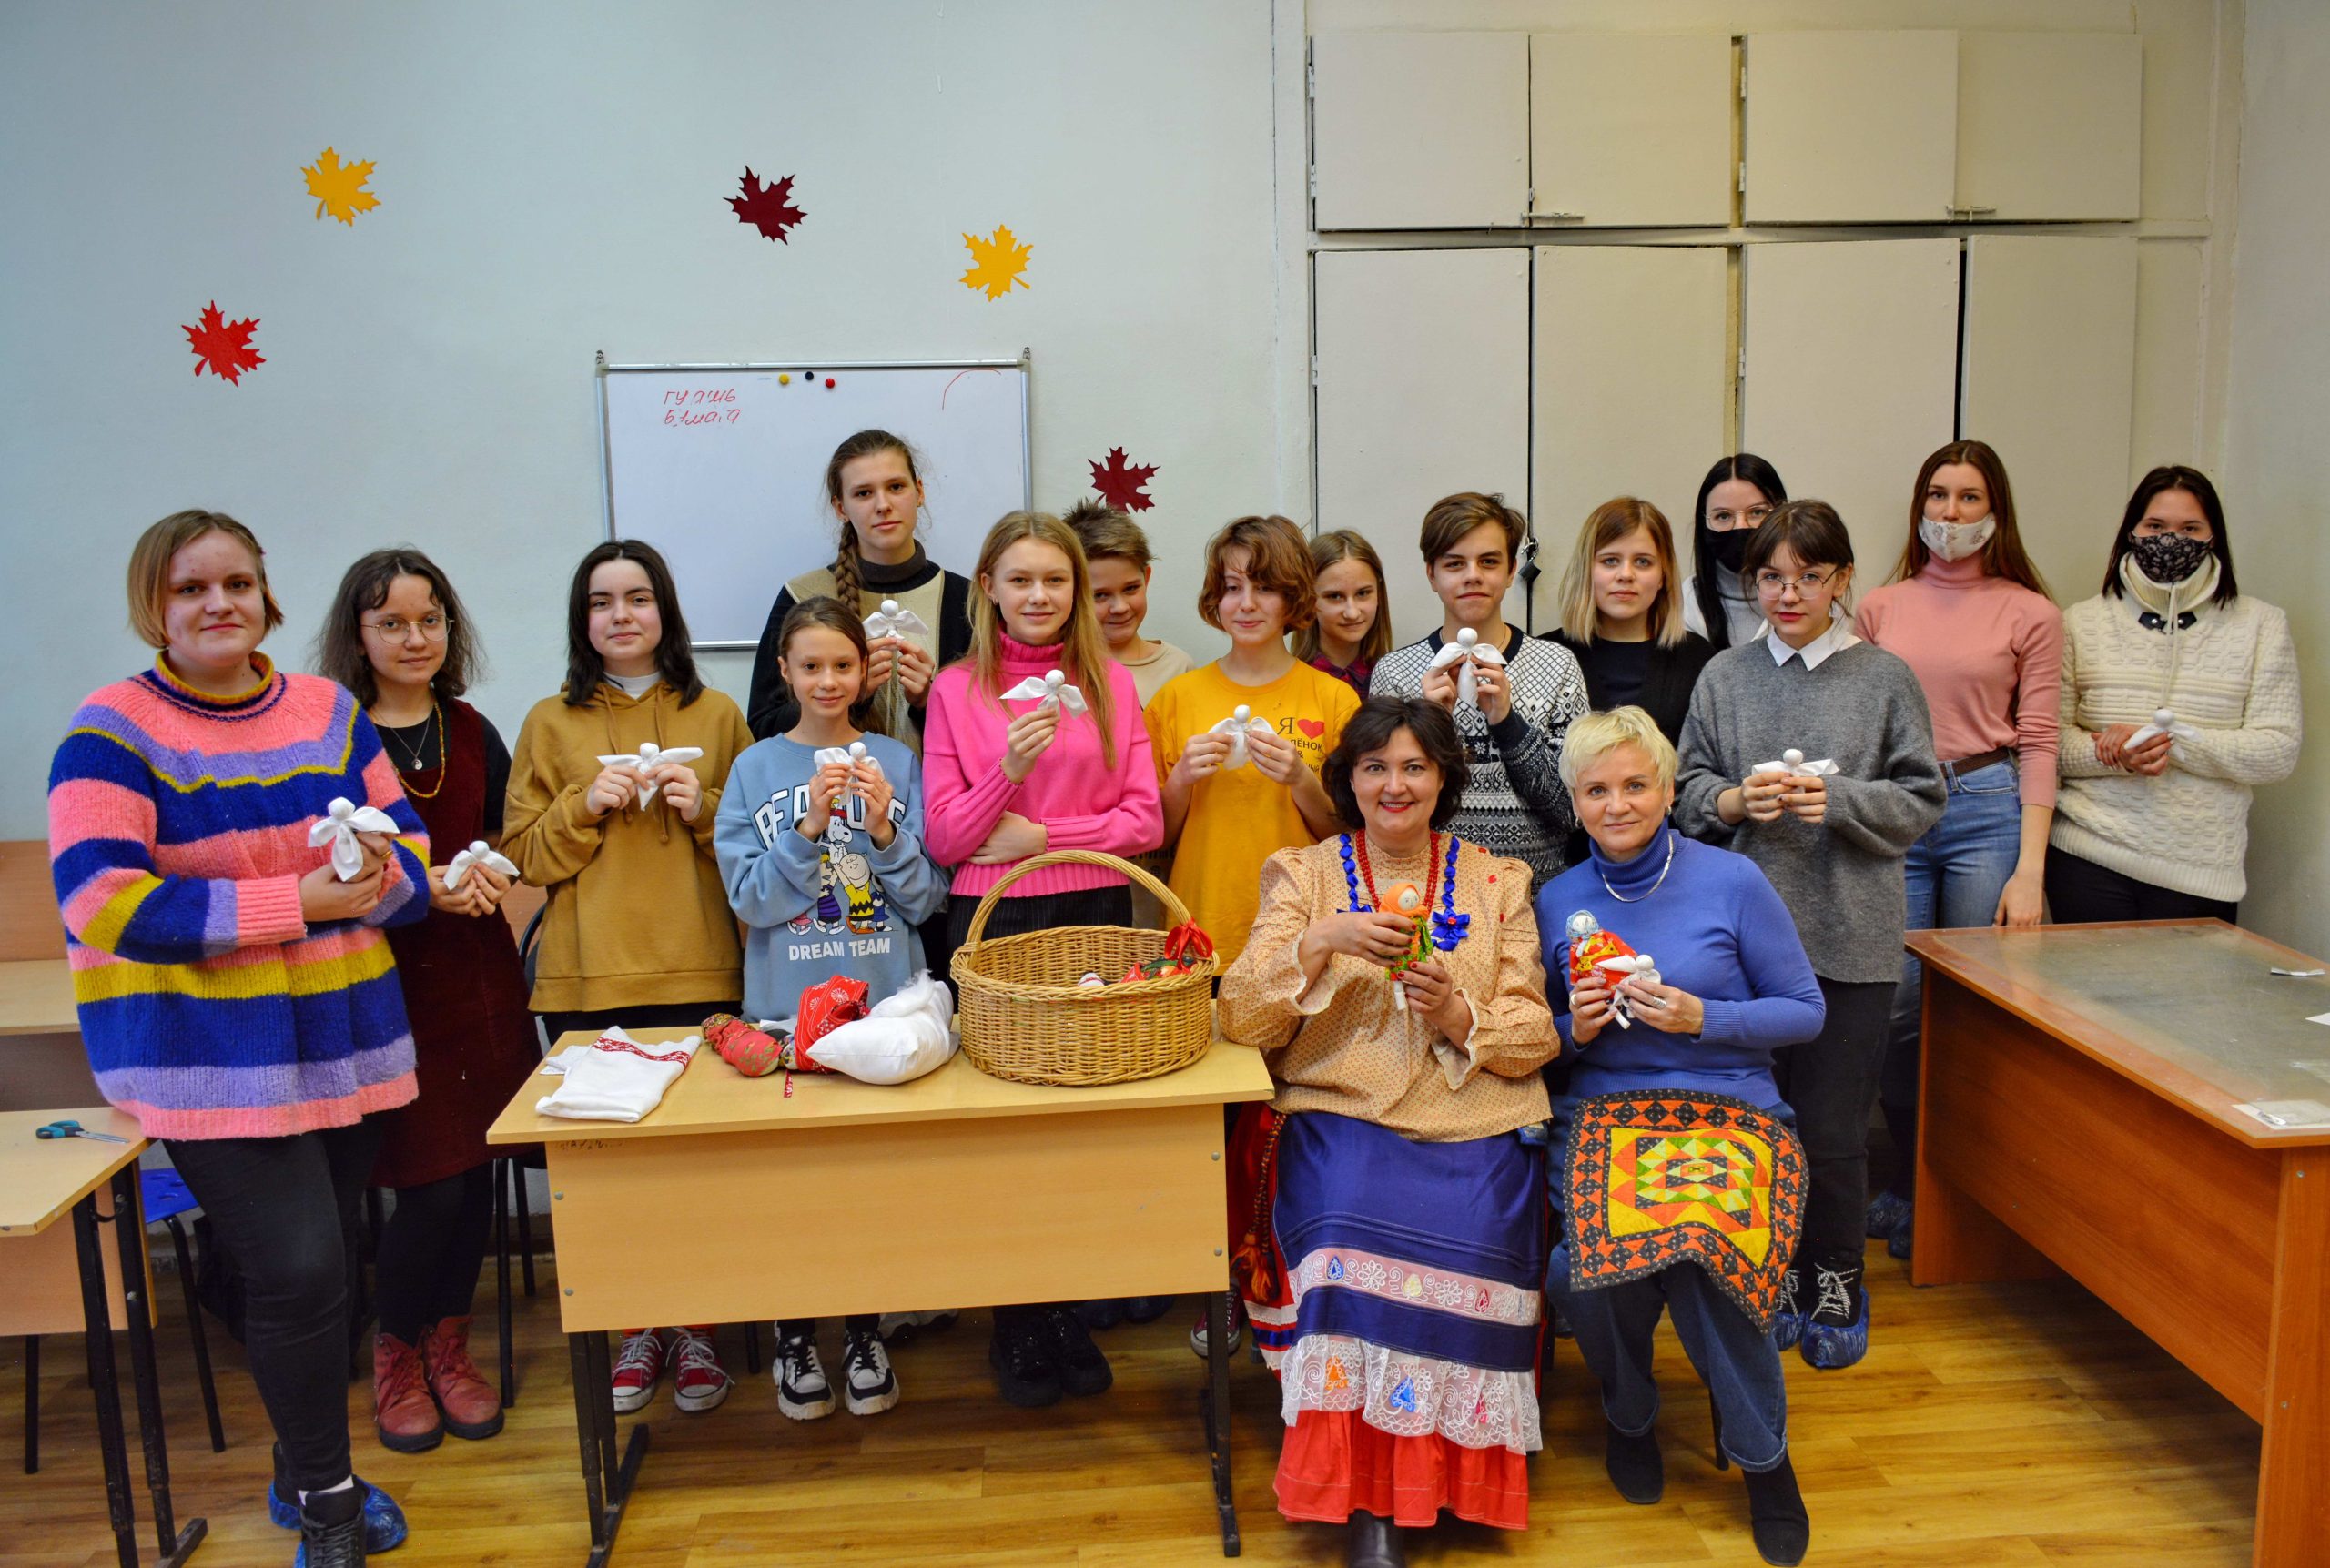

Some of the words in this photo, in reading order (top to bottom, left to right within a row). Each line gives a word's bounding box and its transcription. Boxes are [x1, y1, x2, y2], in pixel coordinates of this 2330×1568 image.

[1277, 716, 1296, 735] Я
[788, 940, 845, 961] DREAM
[848, 937, 890, 957] TEAM
